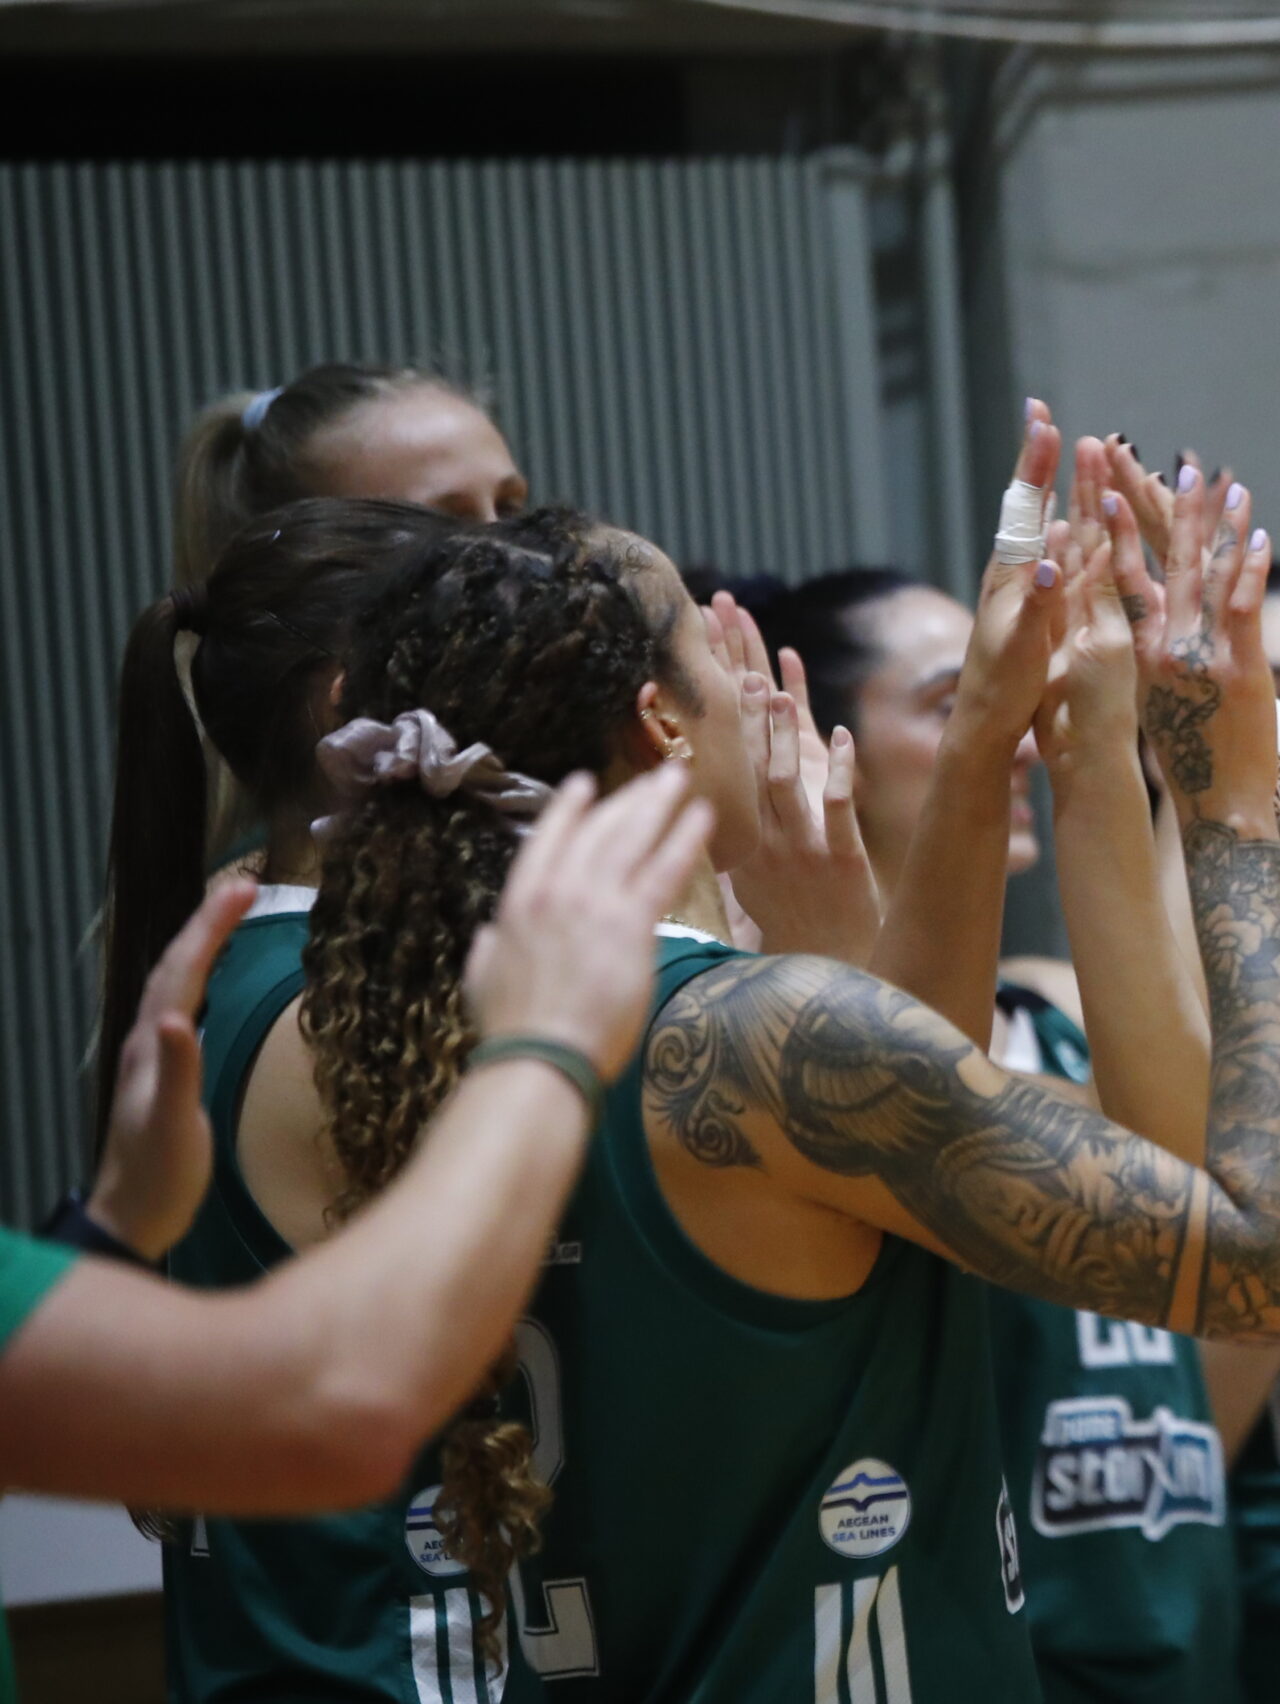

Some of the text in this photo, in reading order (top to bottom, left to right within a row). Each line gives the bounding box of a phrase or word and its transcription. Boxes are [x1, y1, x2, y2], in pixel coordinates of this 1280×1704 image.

[838, 1515, 888, 1529] AEGEAN
[832, 1527, 896, 1543] SEA LINES
